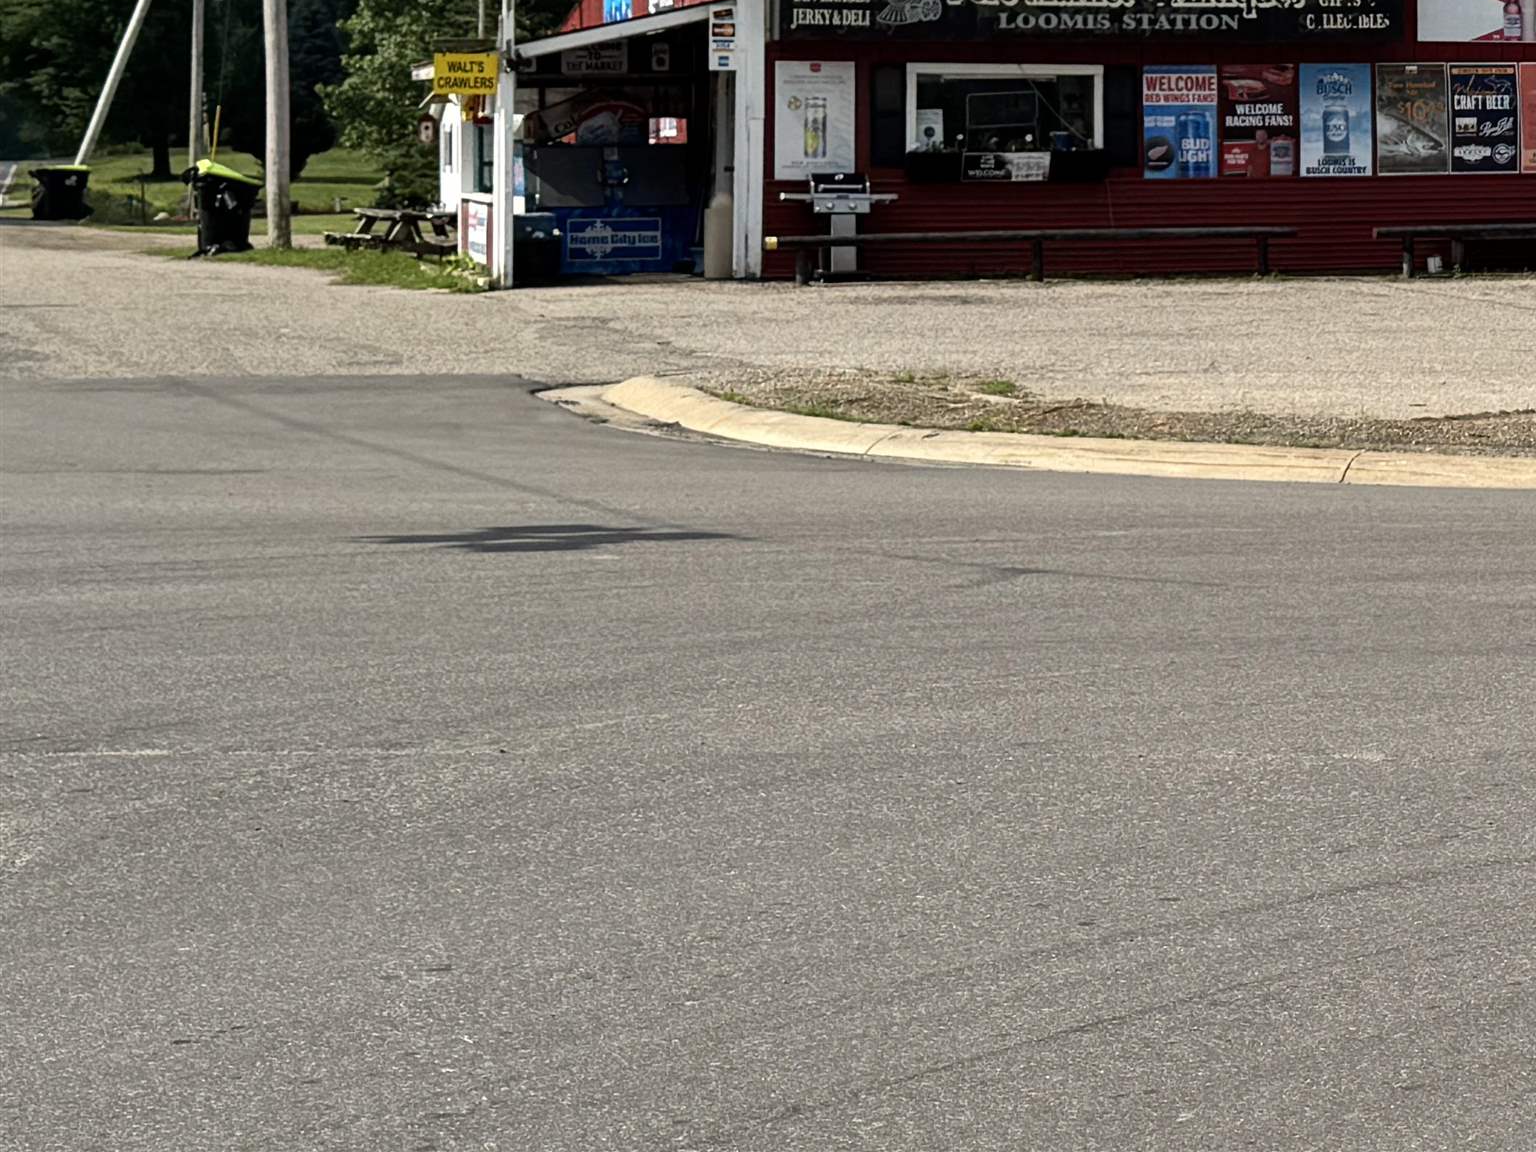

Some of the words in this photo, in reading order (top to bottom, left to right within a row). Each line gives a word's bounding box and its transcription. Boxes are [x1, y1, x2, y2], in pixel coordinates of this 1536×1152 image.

[999, 11, 1111, 30] LOOMIS
[1122, 13, 1240, 30] STATION
[1306, 12, 1391, 30] CLLECIBLES
[447, 60, 485, 75] WALT'S
[585, 61, 623, 71] MARKET
[437, 75, 496, 90] CRAWLERS
[1145, 75, 1217, 92] WELCOME
[1316, 79, 1352, 96] BUSCH
[1235, 103, 1284, 115] WELCOME
[1454, 94, 1483, 111] CRAFT
[1486, 94, 1511, 111] BEER
[1225, 115, 1263, 127] RACING
[1181, 137, 1210, 150] BUD
[570, 234, 609, 245] Home
[611, 234, 636, 245] City
[638, 234, 658, 244] Ice
